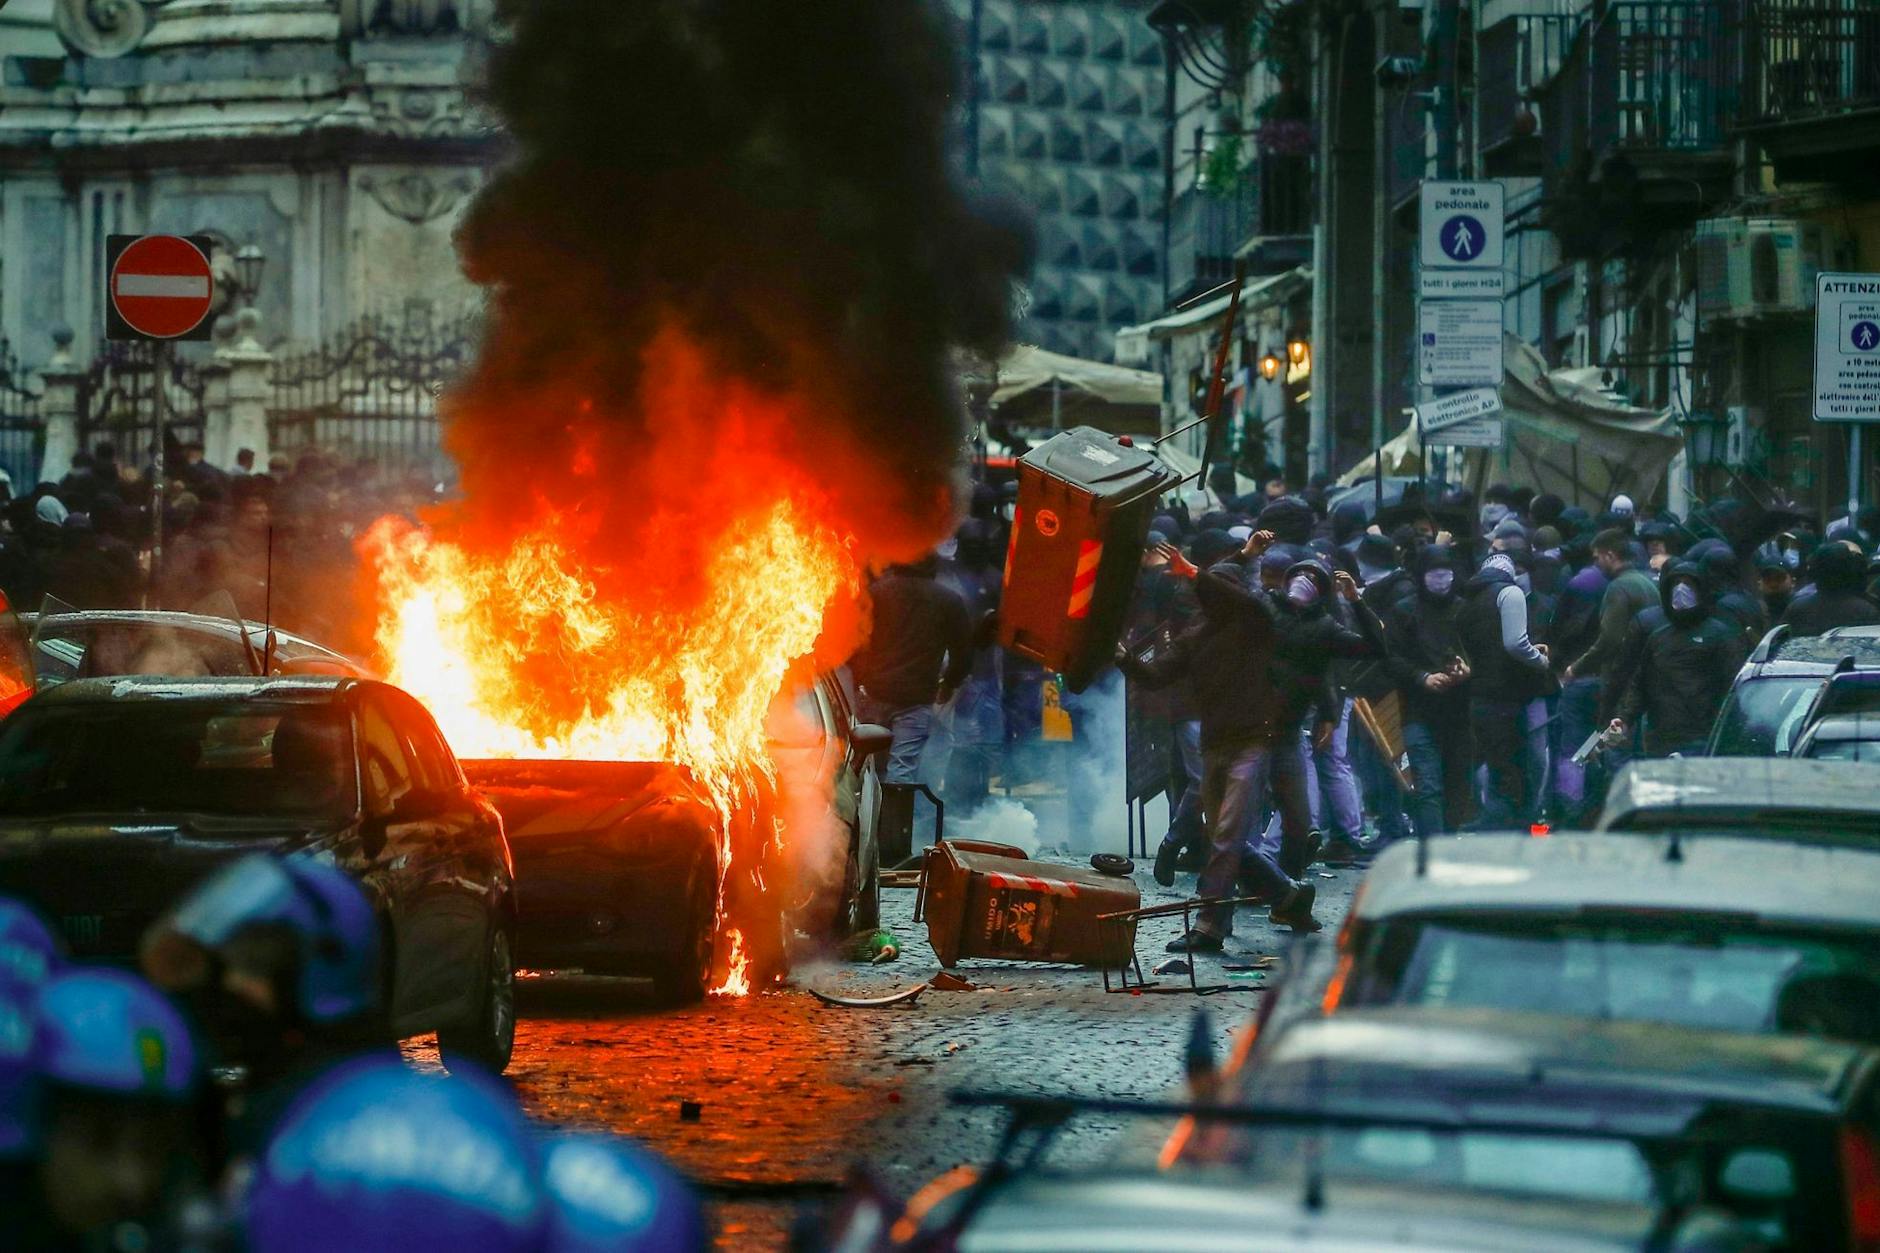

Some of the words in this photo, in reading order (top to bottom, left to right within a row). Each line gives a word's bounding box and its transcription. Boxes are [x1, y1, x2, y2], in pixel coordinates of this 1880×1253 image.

[1449, 187, 1476, 196] area
[1434, 199, 1490, 210] pedonale
[1423, 279, 1443, 288] tutti
[1452, 279, 1478, 290] giorni
[1480, 279, 1501, 288] H24
[1854, 358, 1862, 366] 10
[1436, 392, 1480, 410] controllo
[1819, 392, 1861, 400] elettronico
[1428, 405, 1479, 424] elettronico
[1482, 400, 1495, 410] AP
[1830, 404, 1848, 412] tutti
[1855, 405, 1876, 414] giorni
